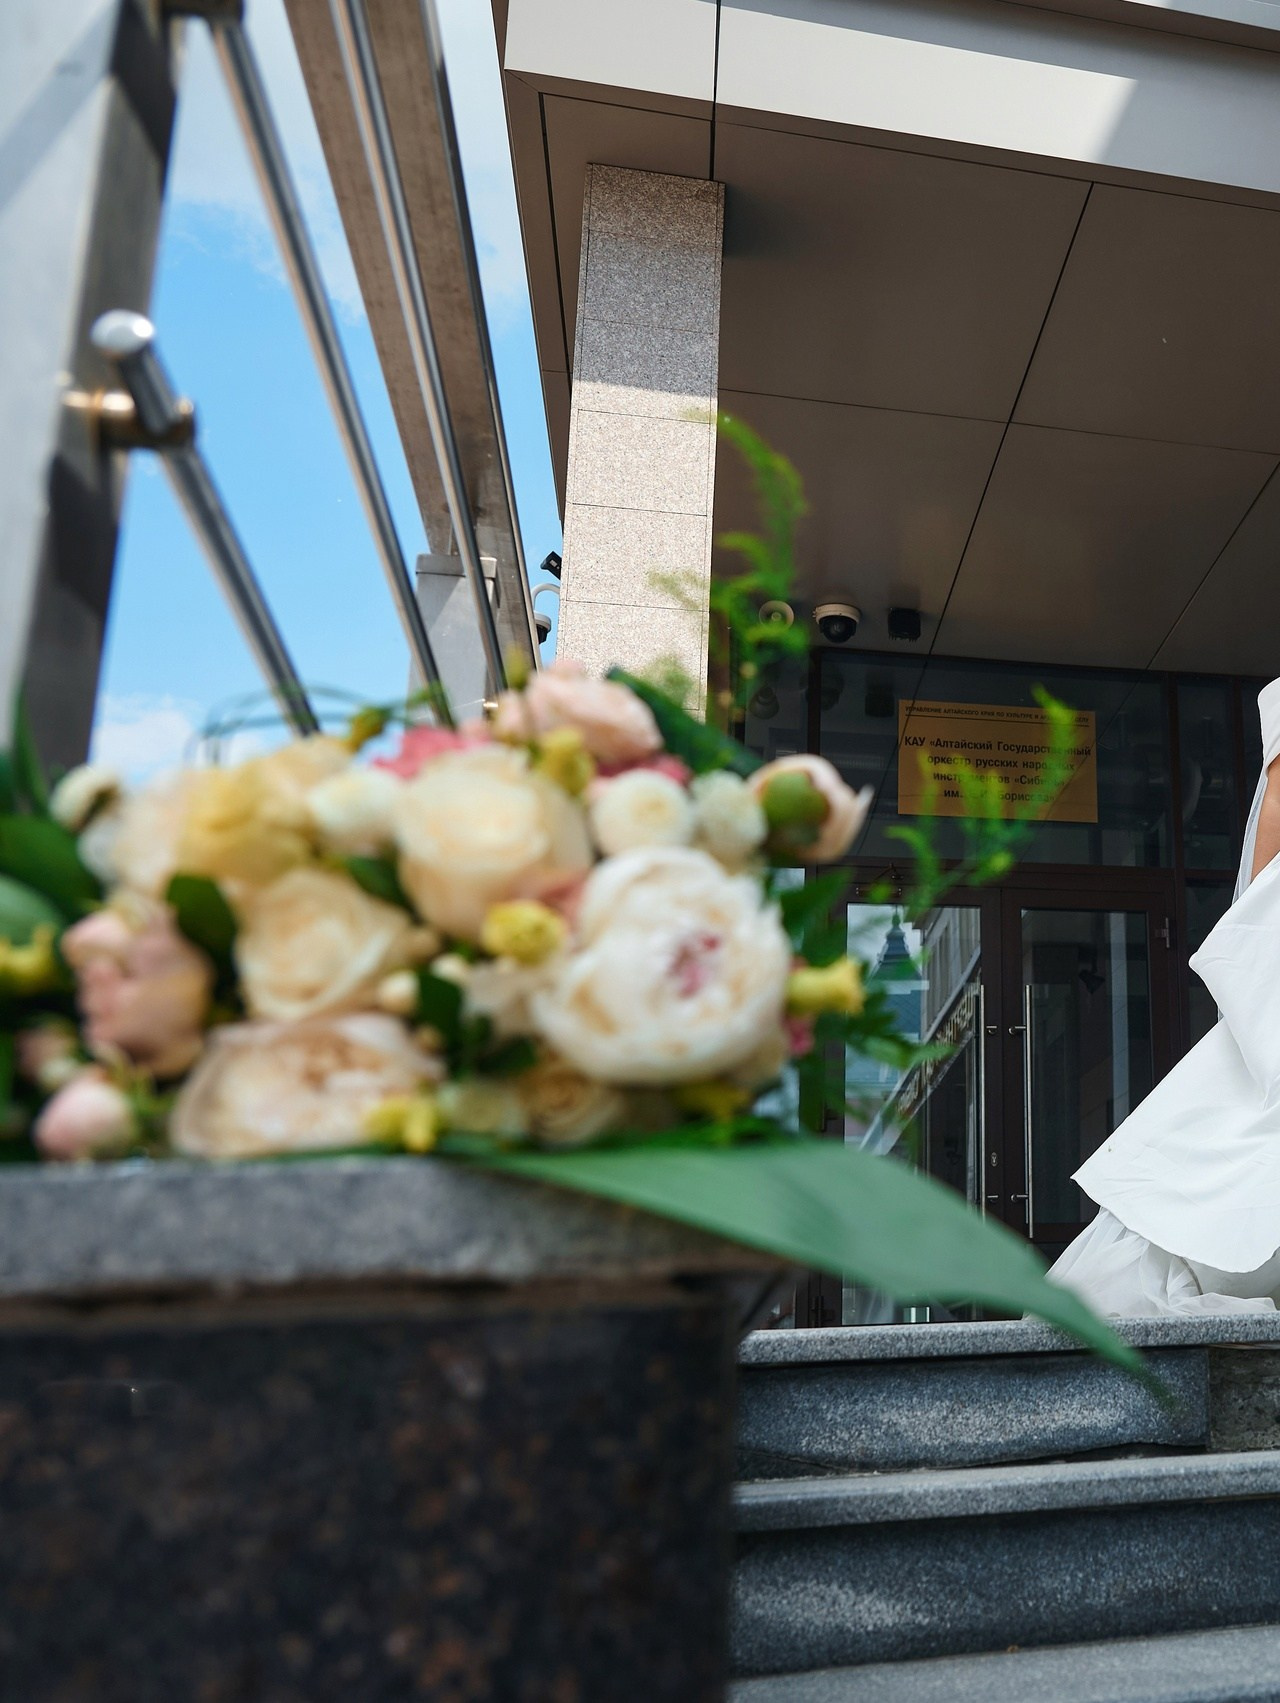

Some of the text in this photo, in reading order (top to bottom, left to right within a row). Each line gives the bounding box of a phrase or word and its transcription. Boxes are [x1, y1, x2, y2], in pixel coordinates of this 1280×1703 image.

[905, 736, 926, 746] КАУ
[929, 738, 993, 750] «Алтайский
[927, 755, 971, 766] оркестр
[975, 758, 1018, 769] русских
